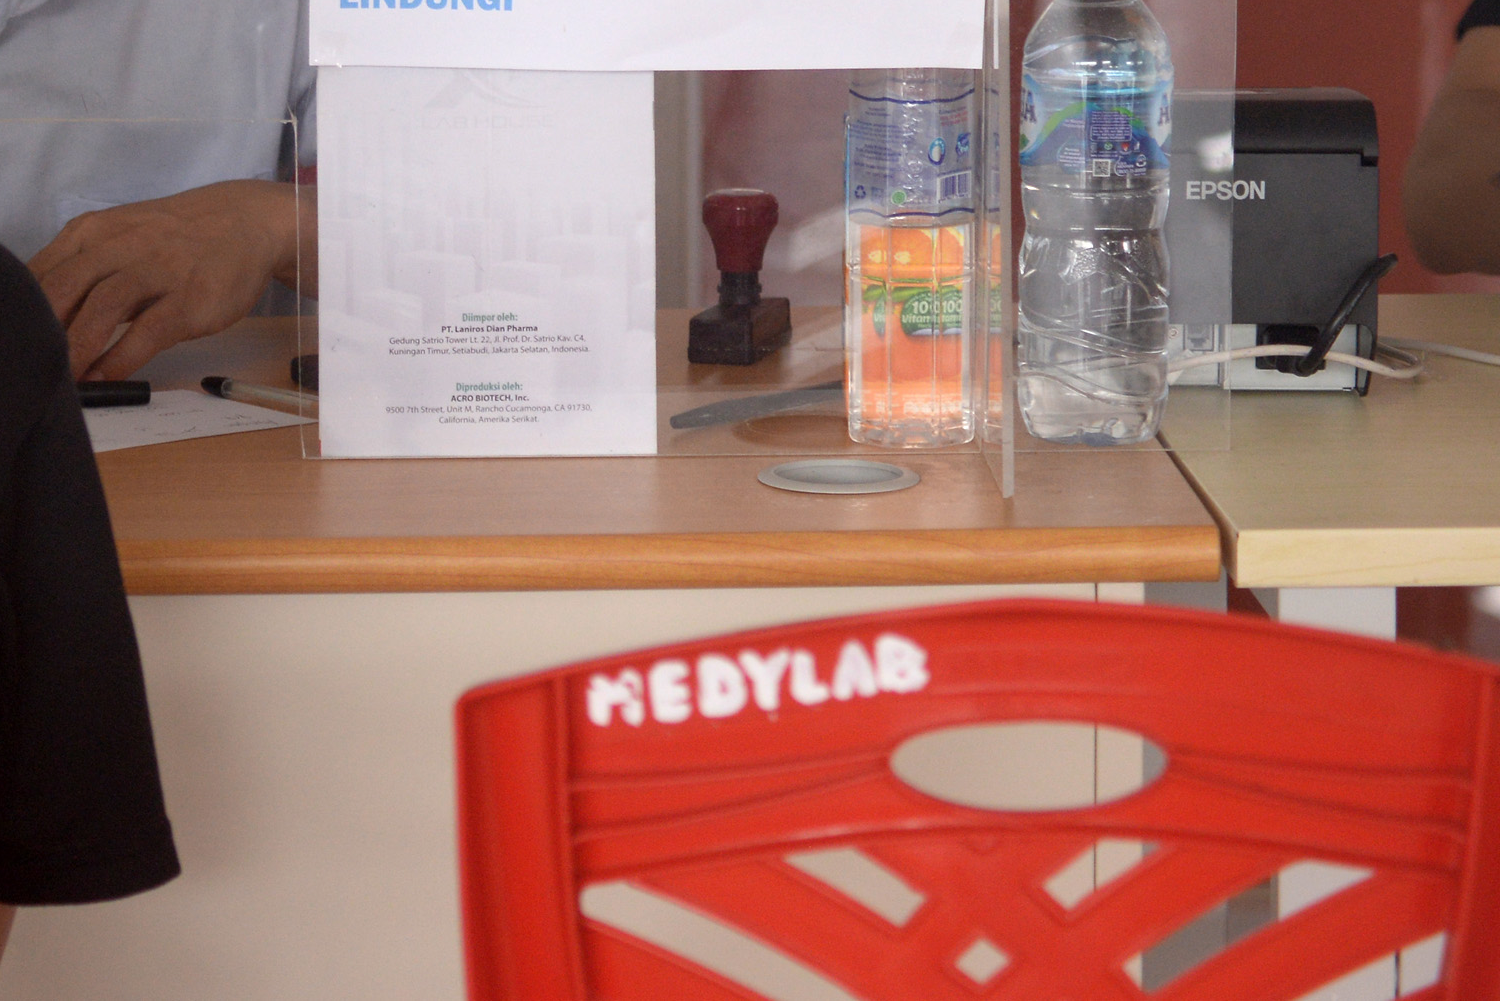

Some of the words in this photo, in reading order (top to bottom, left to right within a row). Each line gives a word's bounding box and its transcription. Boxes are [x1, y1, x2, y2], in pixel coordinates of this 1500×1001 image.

[1185, 180, 1266, 201] EPSON
[462, 313, 495, 323] Diimpor
[497, 313, 518, 321] oleh:
[441, 325, 453, 333] PT.
[486, 325, 506, 333] Dian
[507, 324, 538, 333] Pharma
[389, 337, 420, 346] Gedung
[491, 347, 519, 355] Jakarta
[455, 382, 500, 393] Diproduksi
[502, 382, 523, 391] oleh:
[451, 394, 474, 402] ACRO
[554, 404, 566, 412] CA
[586, 631, 931, 728] MEDYLAB
